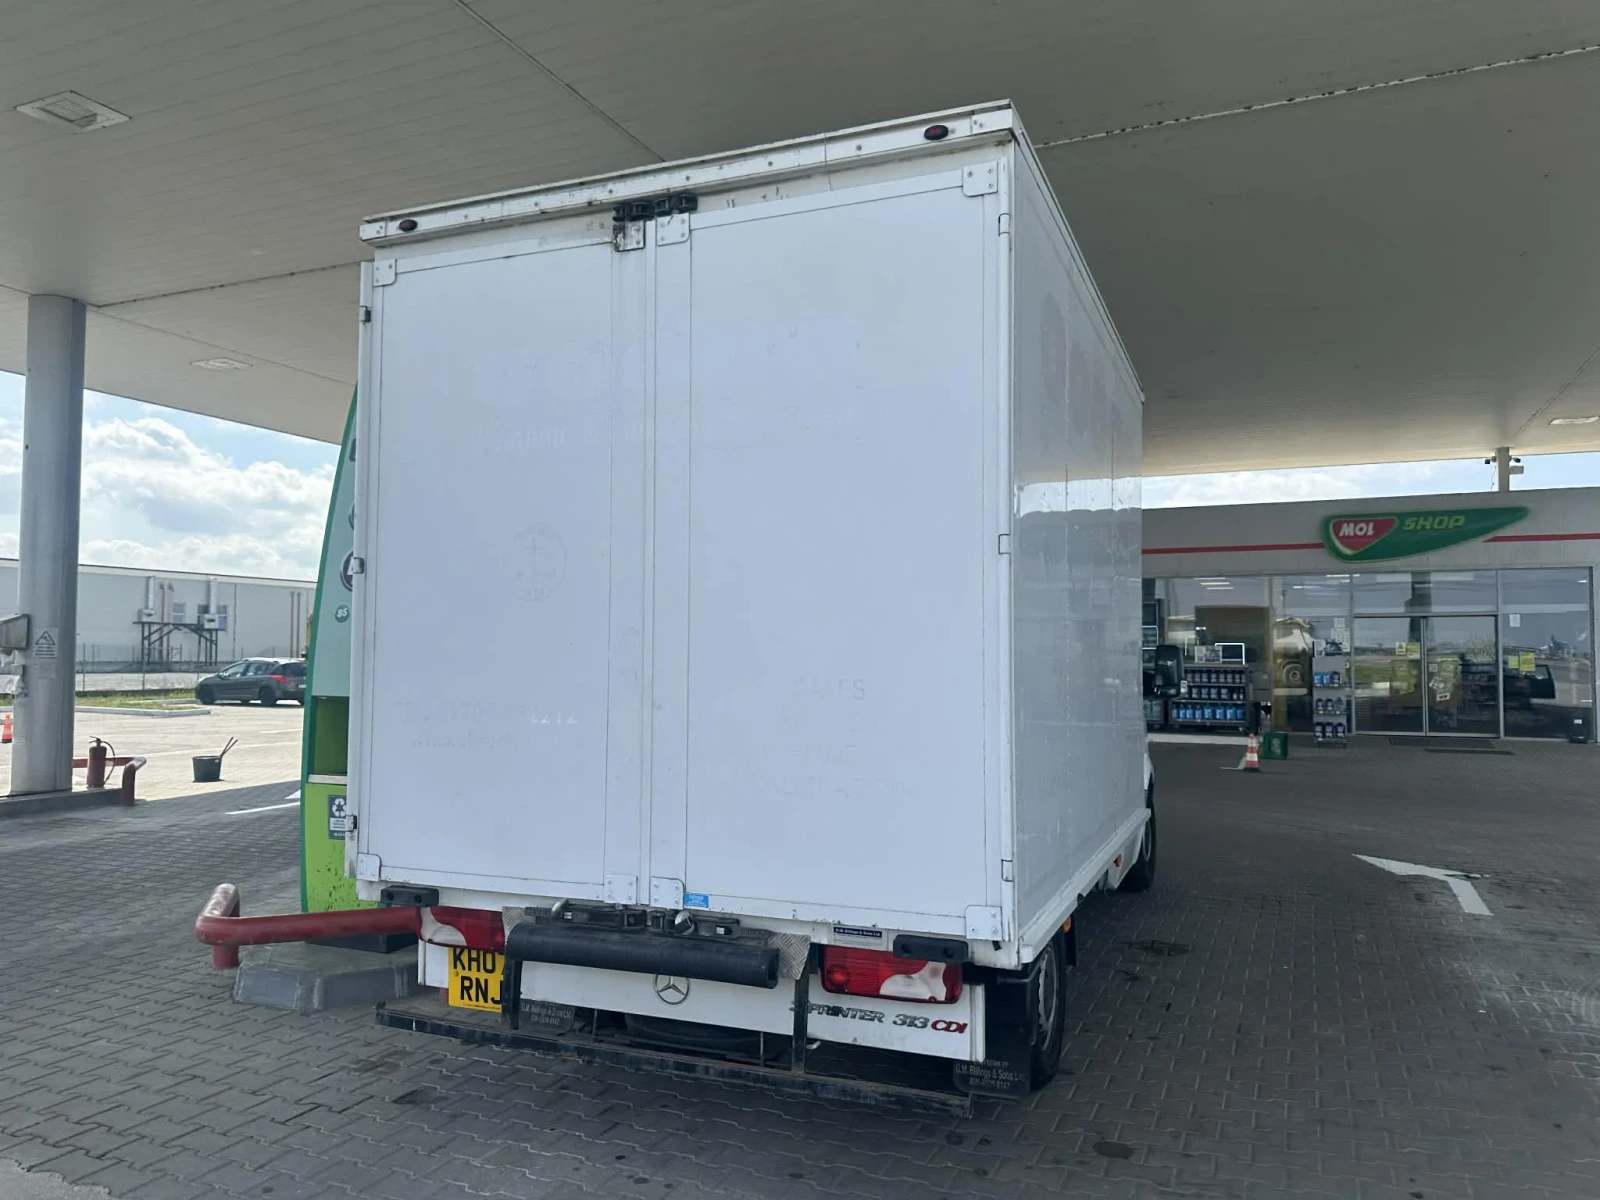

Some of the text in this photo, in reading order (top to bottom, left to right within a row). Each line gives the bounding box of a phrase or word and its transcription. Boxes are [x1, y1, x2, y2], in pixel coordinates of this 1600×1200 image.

[1339, 515, 1466, 537] MOL SHOP
[789, 1001, 968, 1034] PRINTER 313 CDI
